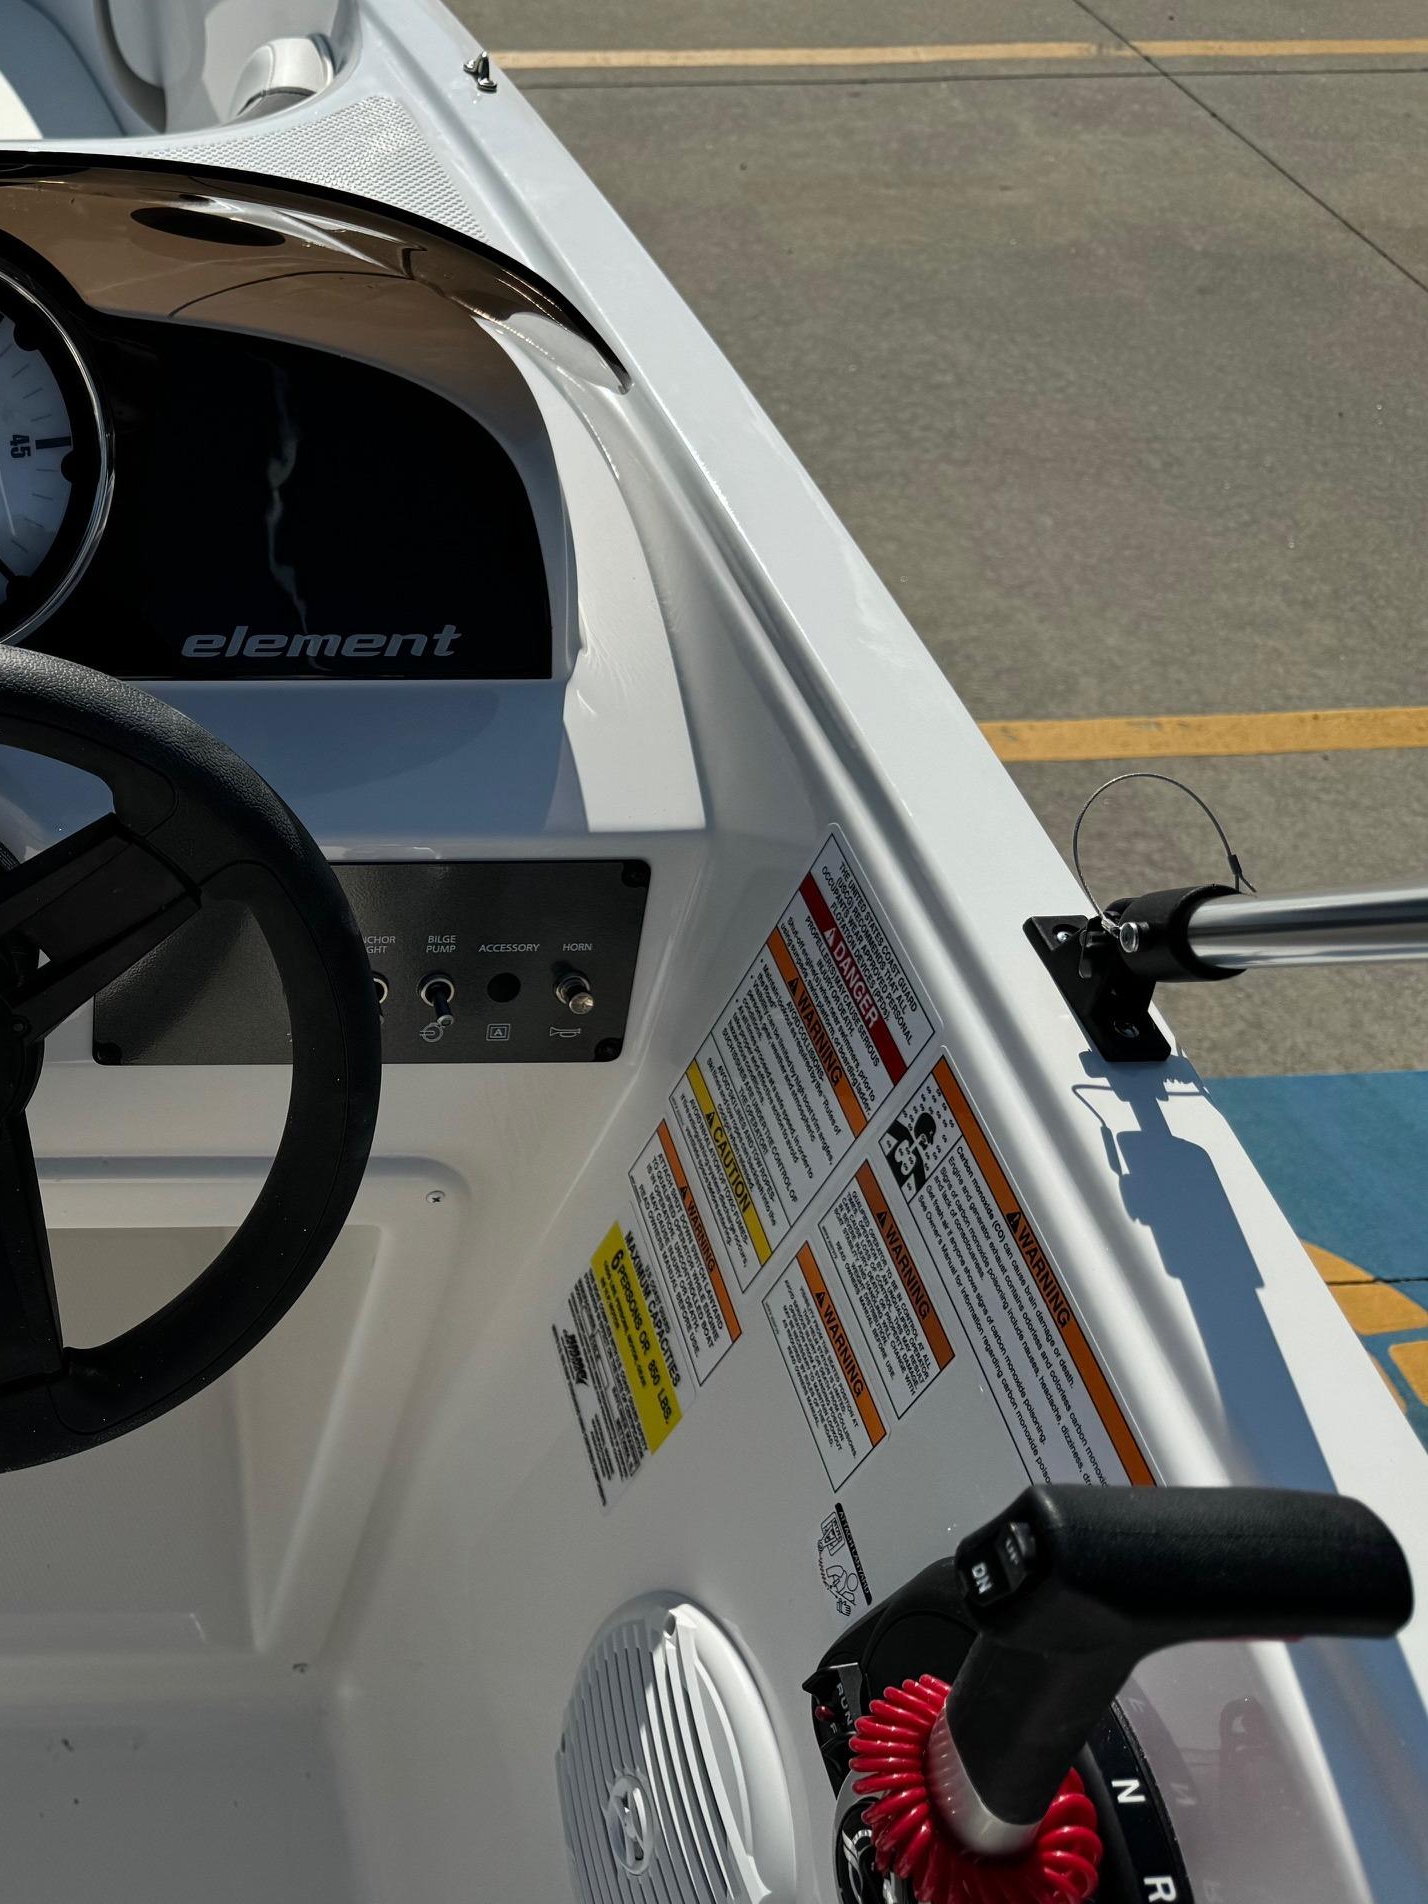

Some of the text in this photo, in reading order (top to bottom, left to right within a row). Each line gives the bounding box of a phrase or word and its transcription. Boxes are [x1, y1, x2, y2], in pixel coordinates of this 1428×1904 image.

[9, 433, 31, 460] 45
[181, 624, 462, 659] element
[426, 945, 456, 953] PUMP
[428, 935, 457, 944] BILGE
[479, 943, 540, 953] ACCESSORY
[562, 943, 593, 952] HORN
[822, 866, 912, 1045] OCCUPANTS WEAR APPROVED PERSONAL
[830, 902, 856, 950] FLOTATION
[854, 948, 875, 989] DEVICES
[836, 877, 907, 1015] (USCG) RECOMMENDS THAT ALL
[839, 861, 917, 1012] THE UNITED STATES COAST GUARD
[802, 945, 821, 987] engine(s)
[819, 984, 831, 1007] when
[829, 1006, 840, 1026] near
[838, 1025, 860, 1071] swimmers,
[856, 1068, 872, 1094] prior
[868, 1088, 876, 1102] to
[805, 916, 879, 1067] PROPELLER(S) MAY CAUSE SERIOUS
[816, 959, 855, 1037] INJURY OR DEATH.
[834, 942, 878, 1027] DANGER
[798, 991, 842, 1086] WARNING
[713, 1127, 750, 1213] CAUTION
[688, 1201, 715, 1272] WARNING
[886, 1224, 930, 1320] WARNING
[934, 1175, 984, 1280] and lack of consciousness.
[957, 1146, 1076, 1388] Carbon monoxide (CO) can cause brain damage or death.
[625, 1231, 651, 1300] MAXIMUM
[648, 1300, 680, 1387] CAPACITIES
[926, 1185, 1046, 1445] Get fresh air if anyone shows signs of carbon monoxide poisoning.
[940, 1166, 1083, 1472] Signs of carbon monoxide poisoning include nausea, headache, dizziness,
[948, 1156, 964, 1185] Engine
[962, 1185, 973, 1202] and
[969, 1202, 991, 1241] generator
[989, 1241, 1007, 1274] exhaust
[1005, 1275, 1024, 1312] contains
[1022, 1312, 1042, 1350] odorless
[1040, 1351, 1053, 1369] and
[1050, 1370, 1071, 1411] colorless
[1070, 1412, 1087, 1445] carbon
[1014, 1226, 1070, 1327] WARNING
[610, 1246, 624, 1272] 6
[618, 1265, 643, 1330] PERSONS
[639, 1330, 650, 1355] OR
[657, 1388, 672, 1424] LBS.
[824, 1305, 863, 1397] WARNING
[918, 1194, 927, 1212] See
[941, 1244, 957, 1275] Manual
[954, 1274, 964, 1288] for
[961, 1287, 984, 1335] information
[982, 1335, 1003, 1378] regarding
[1001, 1378, 1018, 1410] carbon
[1016, 1411, 1038, 1456] monoxide
[839, 1512, 869, 1593] ATTACH LANYARD
[972, 1562, 992, 1594] DN
[836, 1683, 854, 1726] RUN
[1111, 1779, 1146, 1803] N
[1143, 1875, 1177, 1903] R
